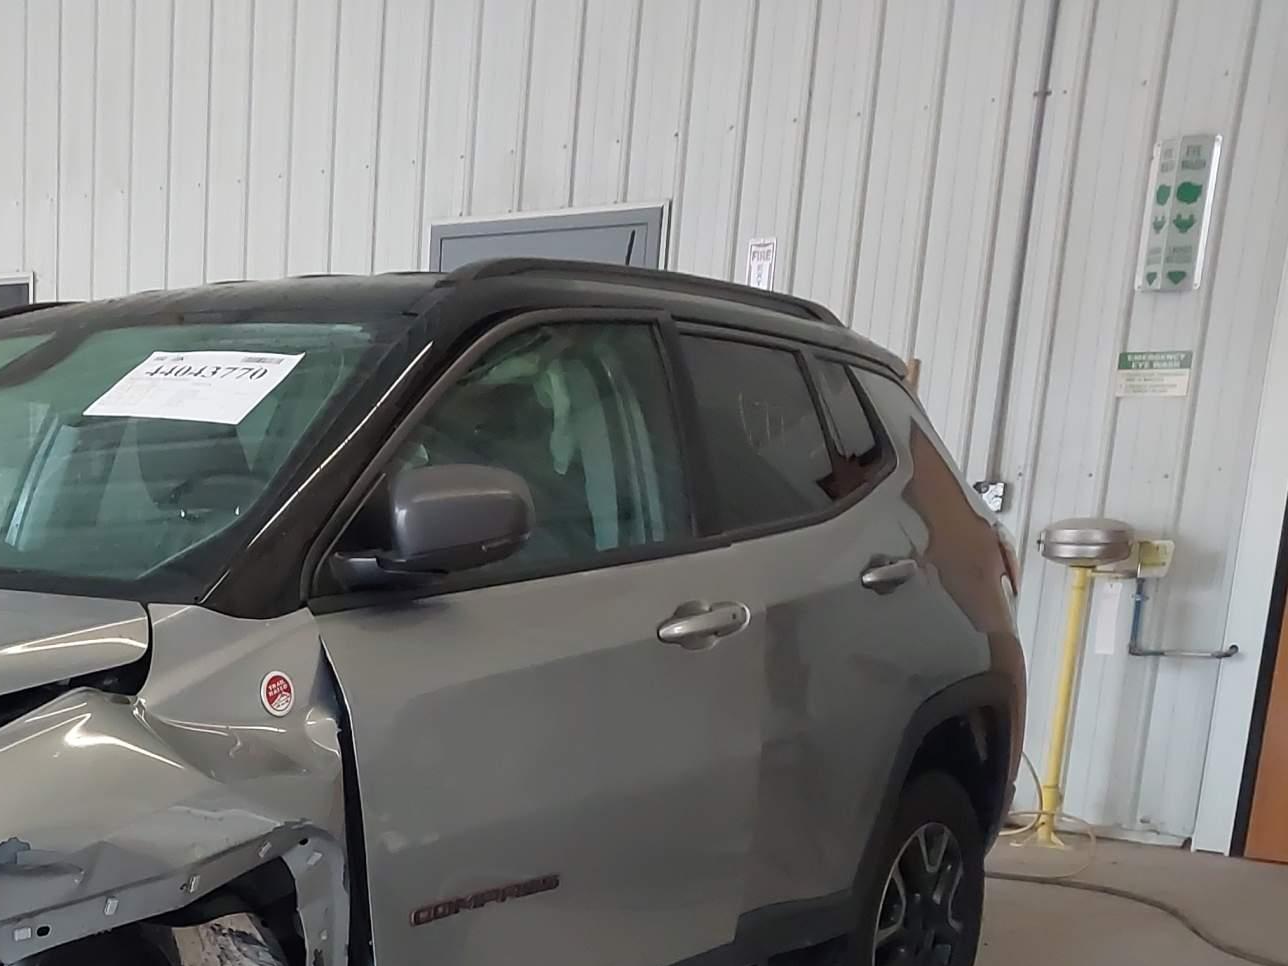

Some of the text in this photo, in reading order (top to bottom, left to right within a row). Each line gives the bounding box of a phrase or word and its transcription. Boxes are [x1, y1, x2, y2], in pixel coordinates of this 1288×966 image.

[752, 249, 772, 262] FIRE
[1127, 353, 1186, 361] EMERGENCY
[1131, 361, 1149, 369] EYE
[145, 364, 269, 381] 44043770
